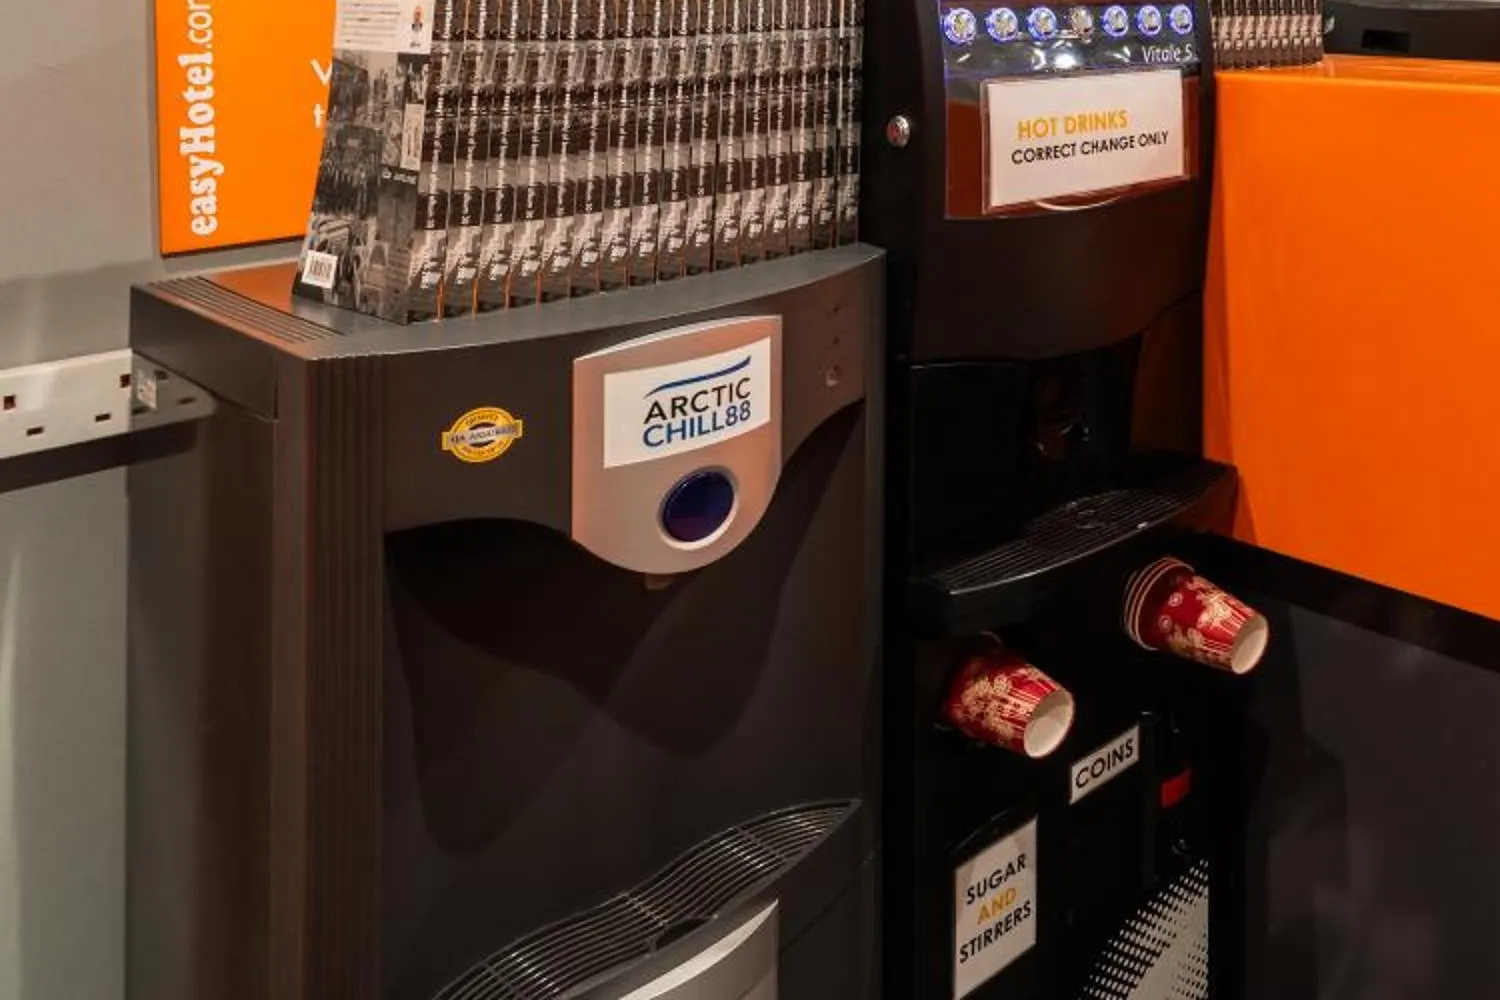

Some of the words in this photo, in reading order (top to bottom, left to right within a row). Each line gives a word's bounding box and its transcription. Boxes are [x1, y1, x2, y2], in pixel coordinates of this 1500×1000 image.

[1011, 142, 1077, 165] CORRECT
[1080, 134, 1136, 156] CHANGE
[1137, 130, 1169, 148] ONLY
[1018, 117, 1059, 140] HOT
[1064, 110, 1129, 136] DRINKS
[642, 400, 752, 448] CHILL88
[643, 376, 752, 424] ARCTIC
[1075, 737, 1134, 790] COINS
[966, 853, 1026, 906] SUGAR
[977, 887, 1017, 924] AND
[959, 900, 1032, 964] STIRRERS
